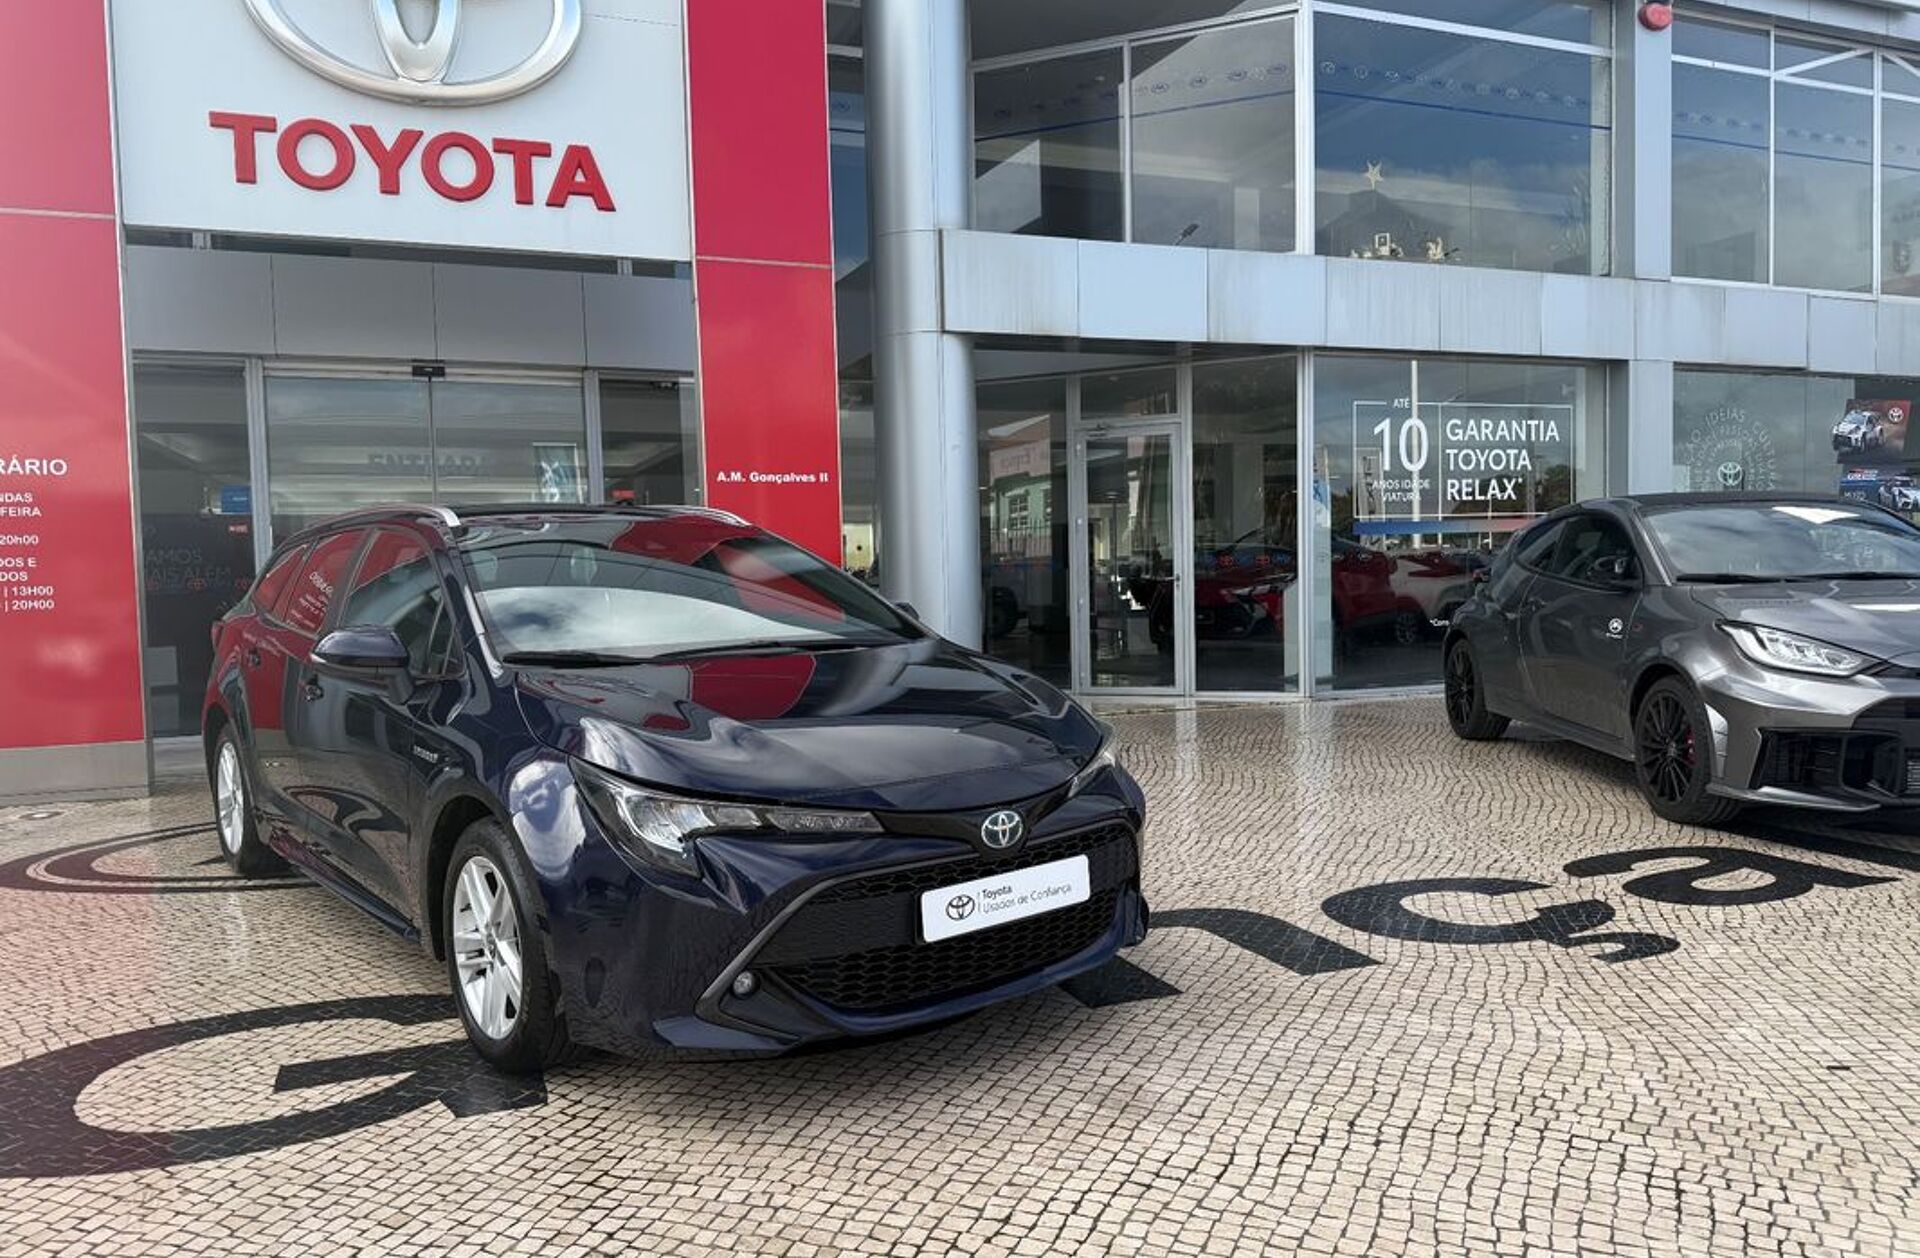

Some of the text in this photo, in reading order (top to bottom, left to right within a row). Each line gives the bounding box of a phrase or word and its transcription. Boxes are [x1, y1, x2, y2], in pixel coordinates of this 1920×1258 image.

[209, 110, 616, 212] TOYOTA
[1445, 418, 1561, 443] GARANTIA
[1373, 418, 1429, 473] 10
[1445, 449, 1533, 472] TOYOTA
[716, 471, 747, 482] A.M.
[749, 471, 817, 484] Gonçalves
[28, 557, 38, 568] E
[12, 586, 54, 596] 13H00
[12, 600, 55, 610] 20H00
[981, 884, 1013, 900] Toyota
[982, 884, 1072, 914] Usados de Confiança
